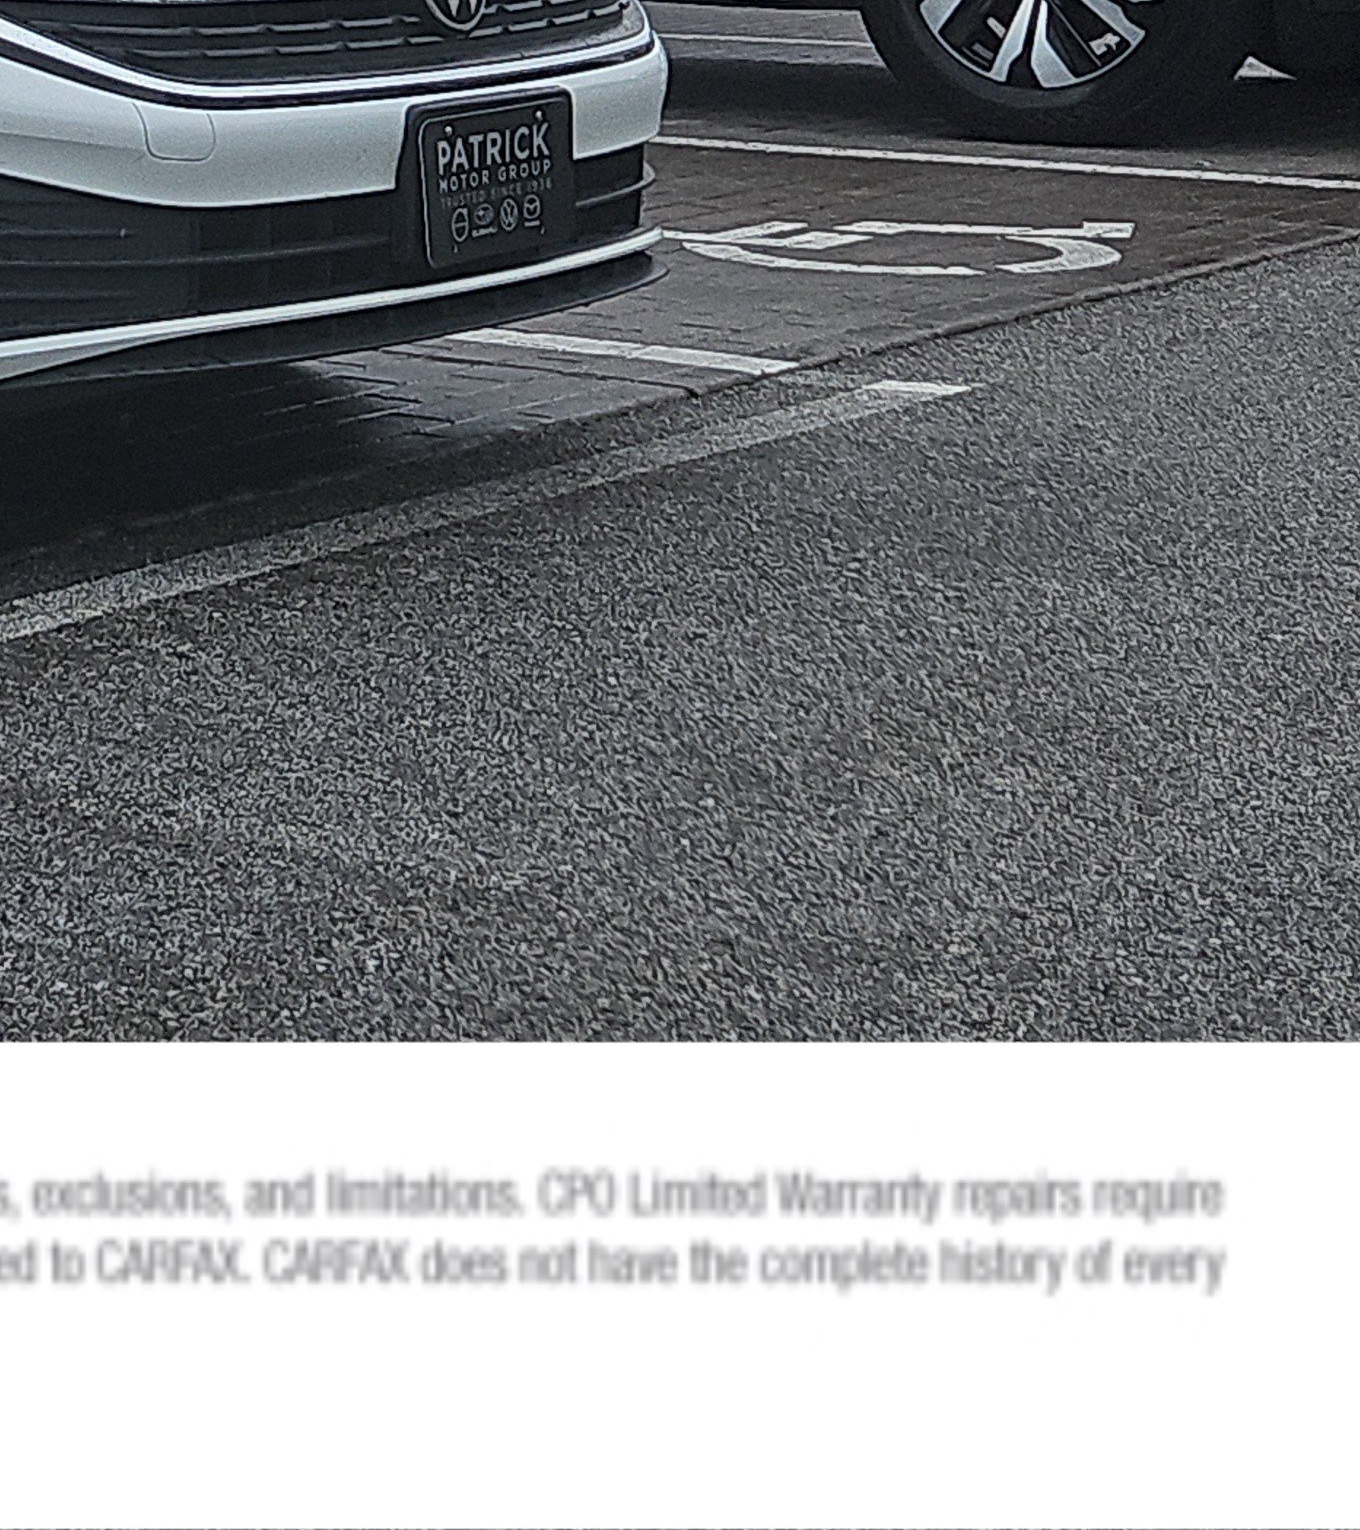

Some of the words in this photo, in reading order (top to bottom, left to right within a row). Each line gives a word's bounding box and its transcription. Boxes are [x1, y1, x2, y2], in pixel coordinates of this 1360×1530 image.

[437, 122, 550, 175] PATRICK
[439, 170, 490, 194] MOTOR
[498, 159, 552, 182] GROUP
